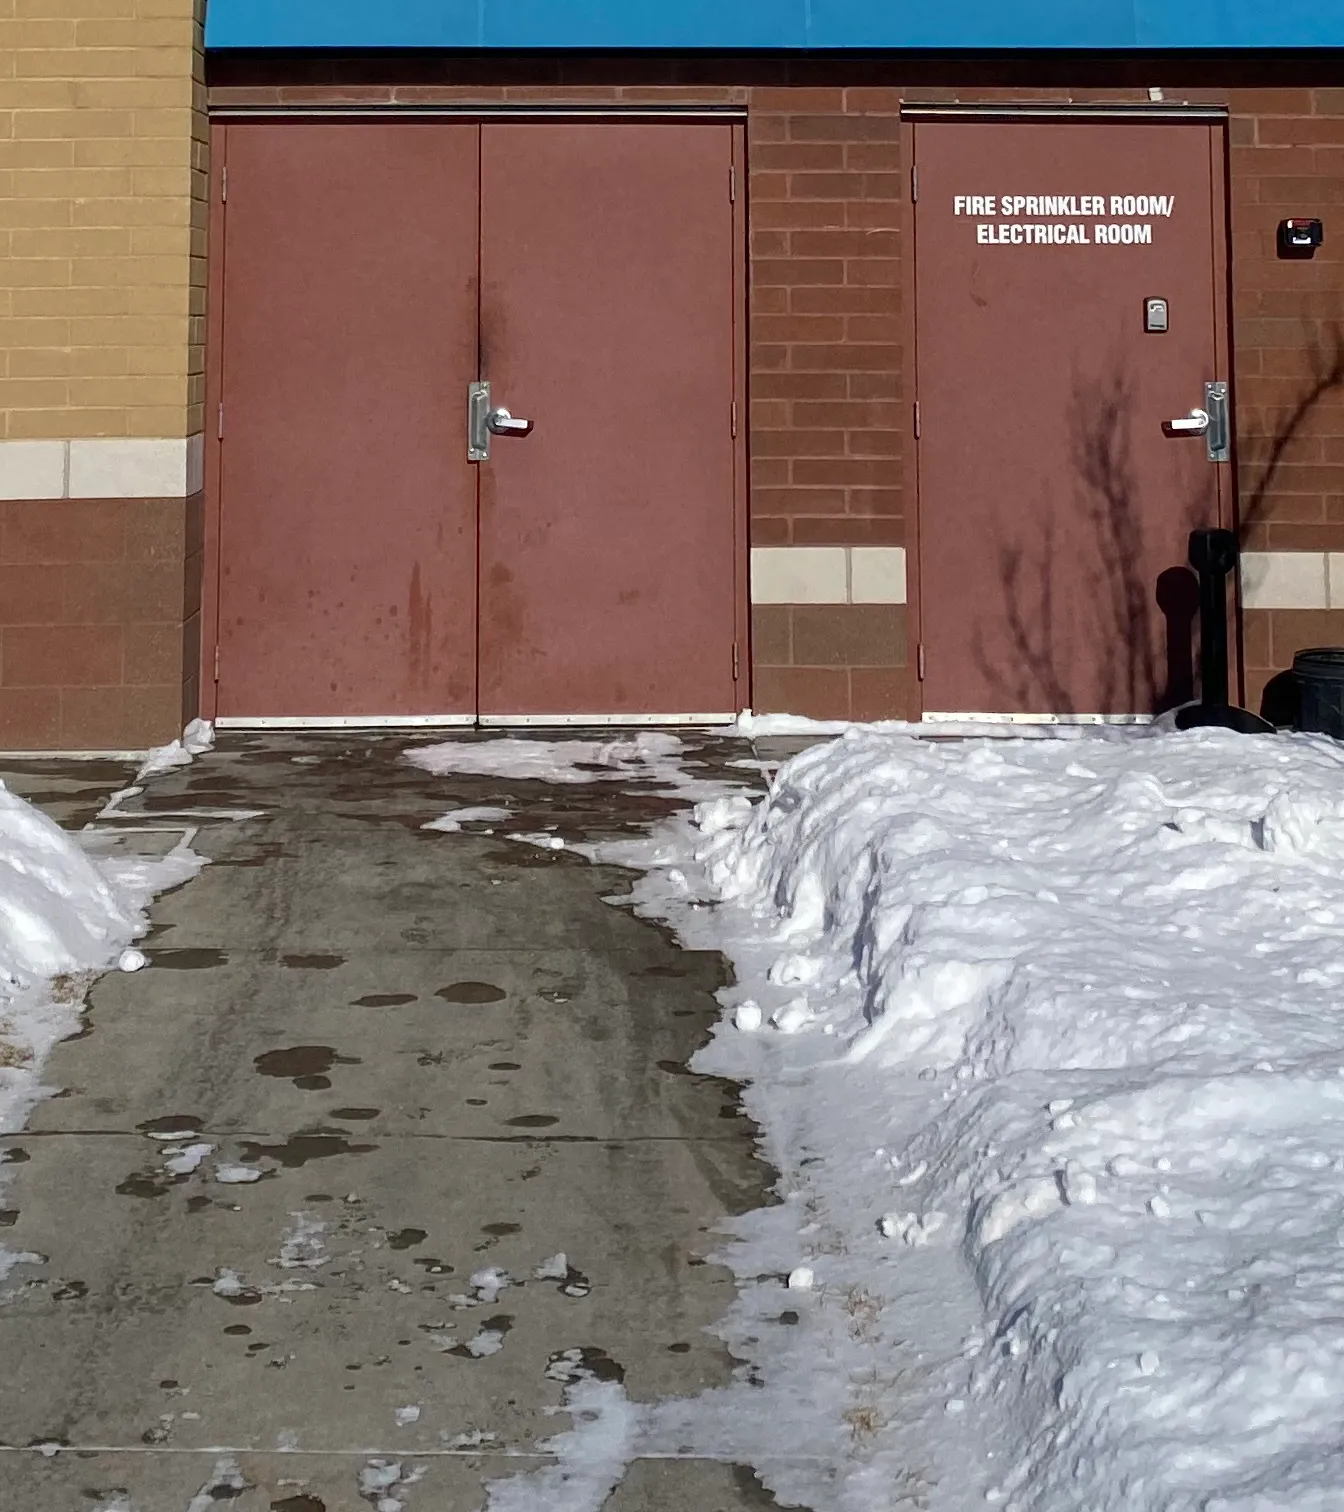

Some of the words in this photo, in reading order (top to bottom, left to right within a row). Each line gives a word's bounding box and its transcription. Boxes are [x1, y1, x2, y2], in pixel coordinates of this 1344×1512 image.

[954, 196, 996, 216] FIRE
[1001, 196, 1105, 216] SPRINKLER
[1110, 196, 1175, 217] ROOM/
[977, 224, 1090, 244] ELECTRICAL
[1095, 224, 1151, 244] ROOM
